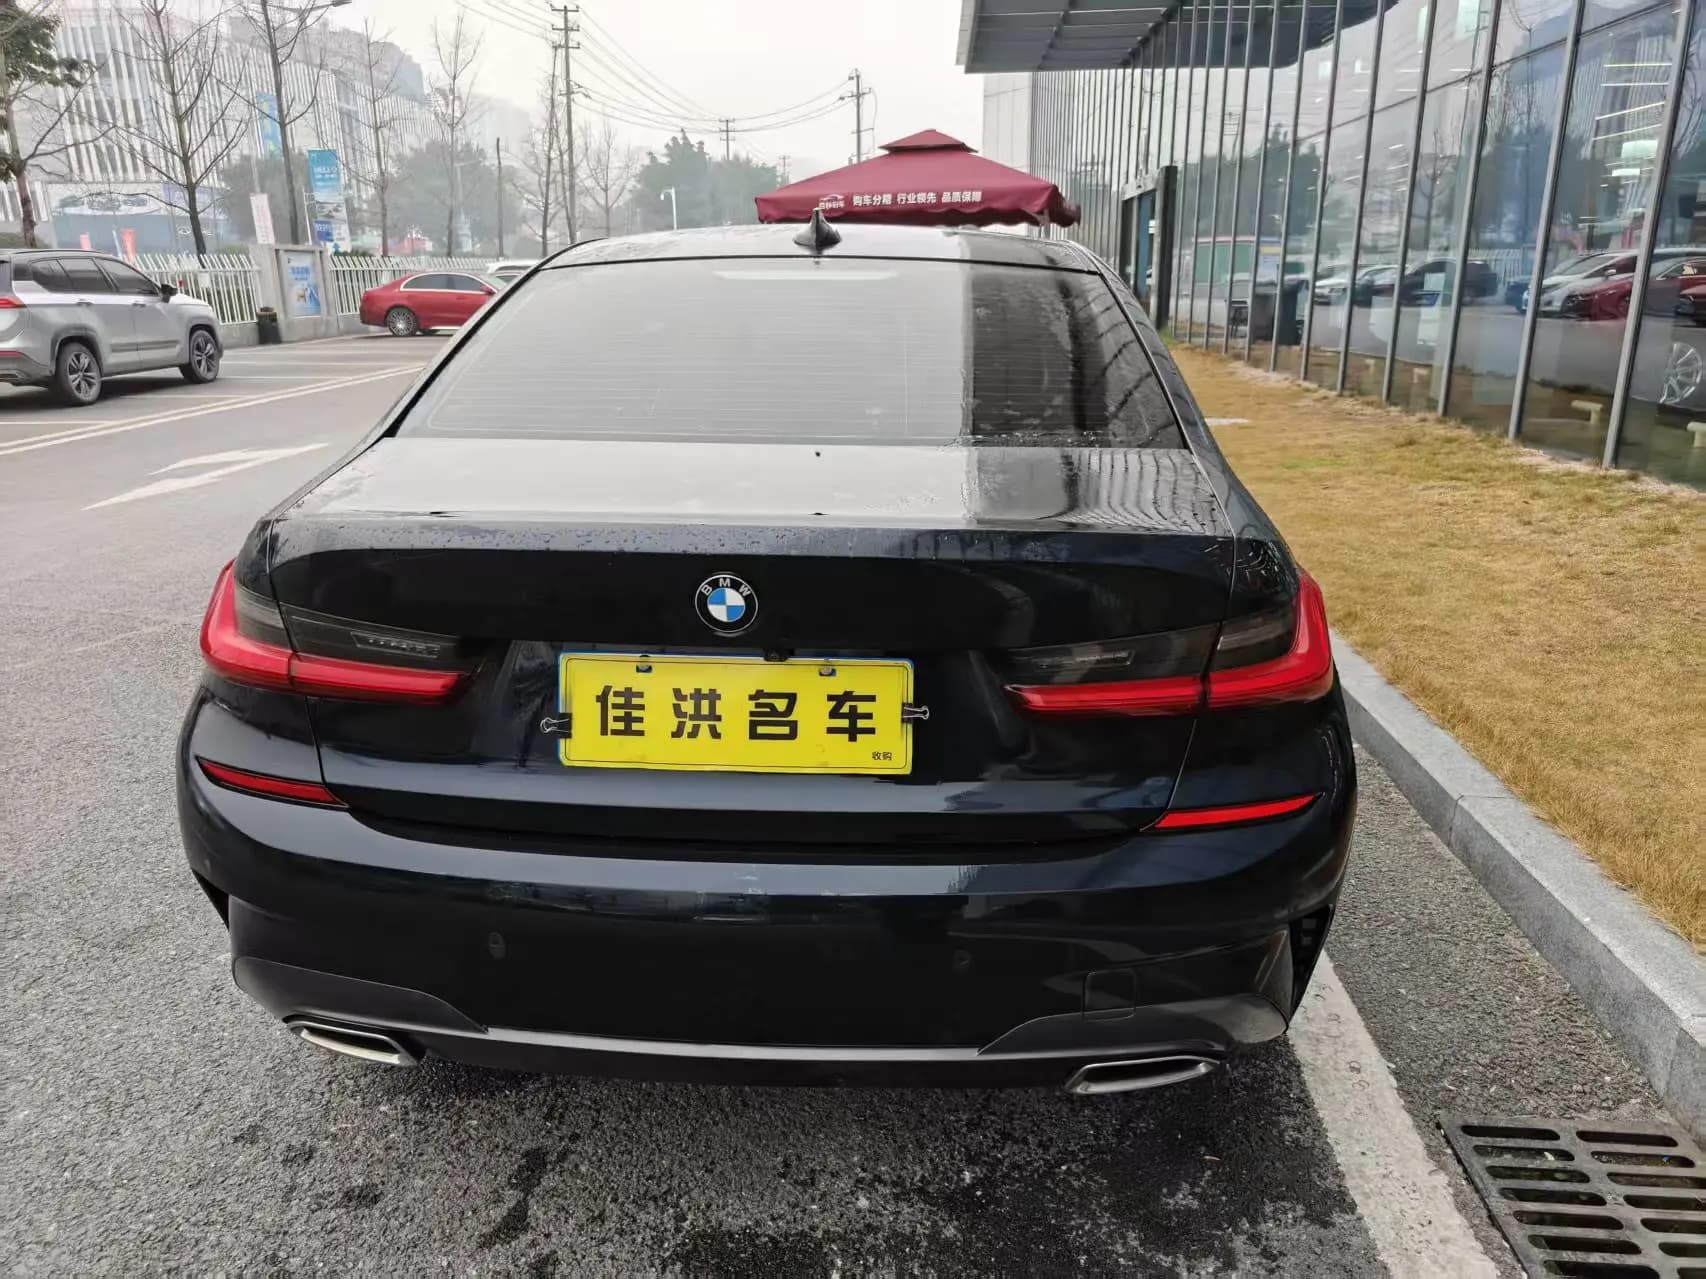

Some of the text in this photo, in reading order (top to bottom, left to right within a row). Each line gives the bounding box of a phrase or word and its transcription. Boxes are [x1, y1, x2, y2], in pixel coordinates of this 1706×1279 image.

[897, 192, 936, 204] 行业领先
[942, 191, 982, 203] 品质保障
[701, 577, 752, 597] BMW
[595, 684, 877, 742] 佳洪名车
[871, 750, 893, 762] 收购
